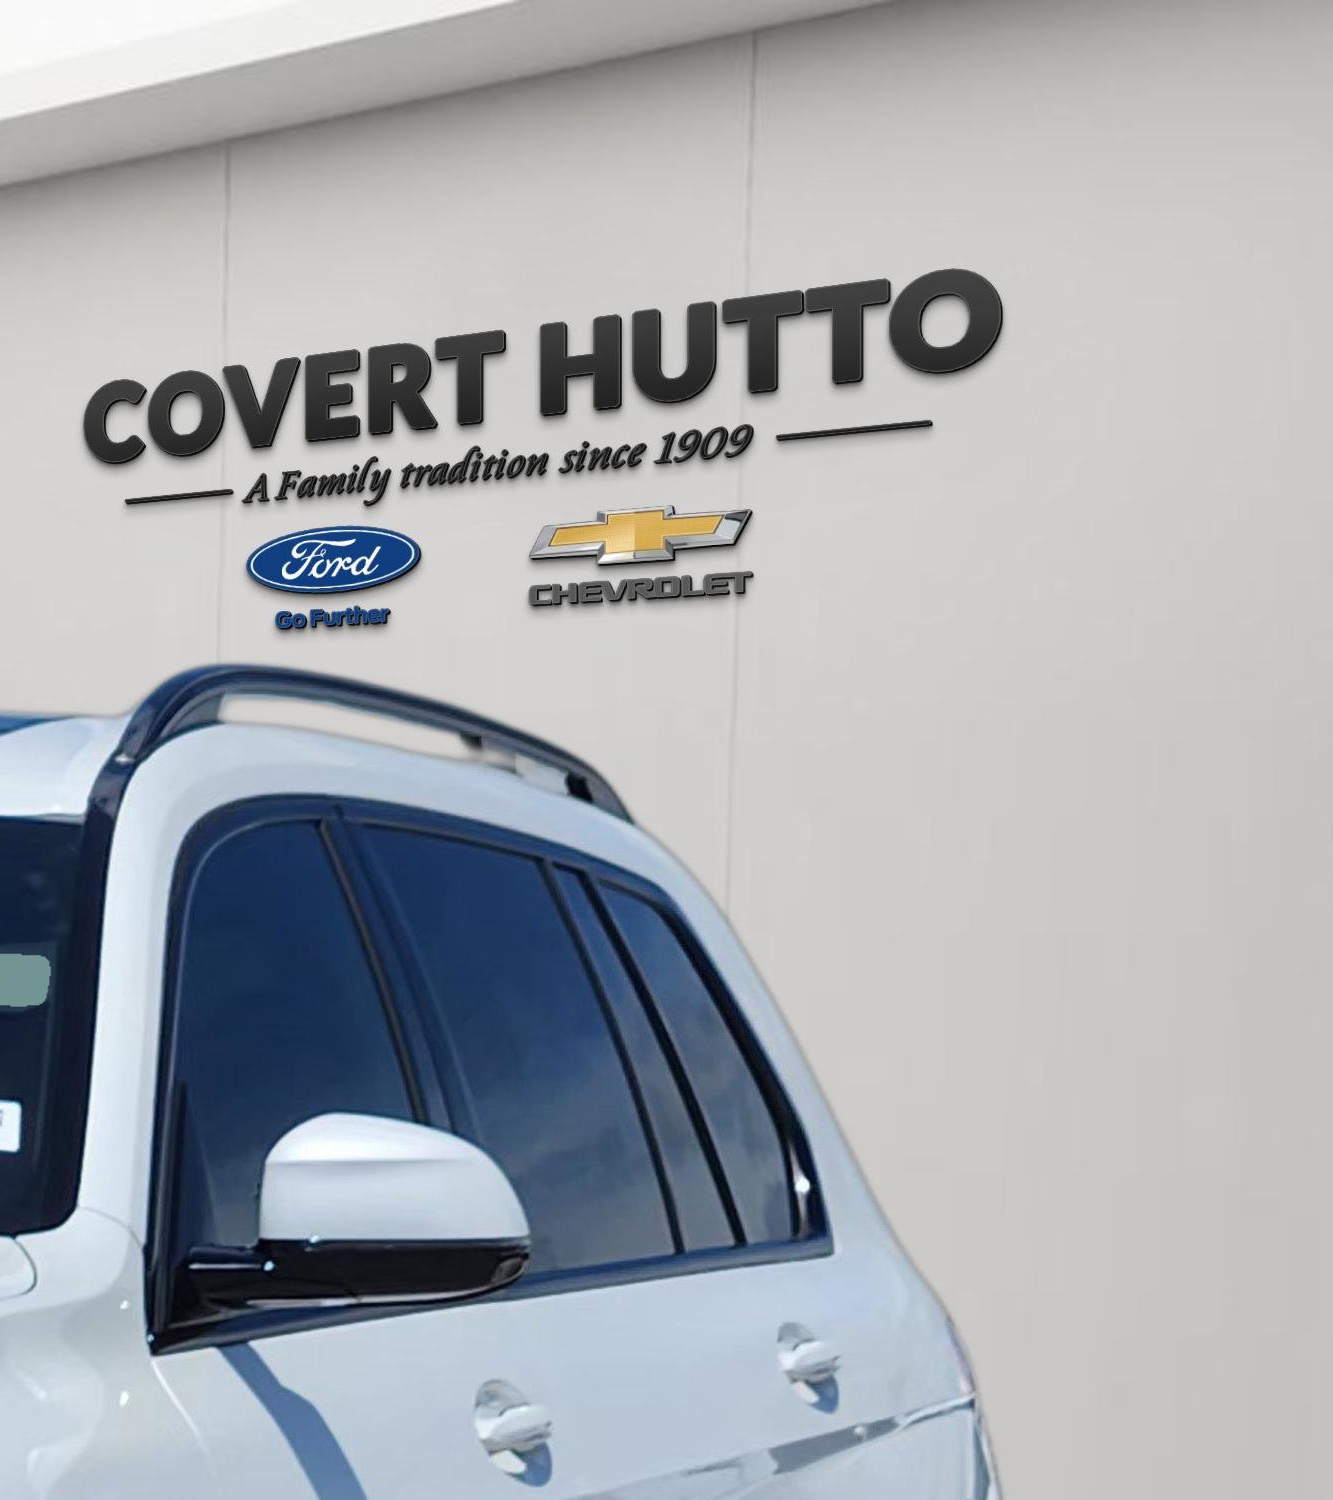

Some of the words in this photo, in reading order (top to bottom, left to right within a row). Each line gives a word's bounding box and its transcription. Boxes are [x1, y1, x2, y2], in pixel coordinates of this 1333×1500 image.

[83, 330, 506, 466] COVERT
[540, 269, 1003, 419] HUTTO
[242, 473, 270, 504] A
[274, 456, 391, 506] Family
[400, 446, 549, 490] tradition
[558, 438, 647, 475] since
[654, 424, 754, 465] 1909
[281, 538, 381, 580] Ford
[529, 572, 754, 608] CHEVROLET
[275, 610, 307, 630] Go
[309, 606, 391, 629] Further
